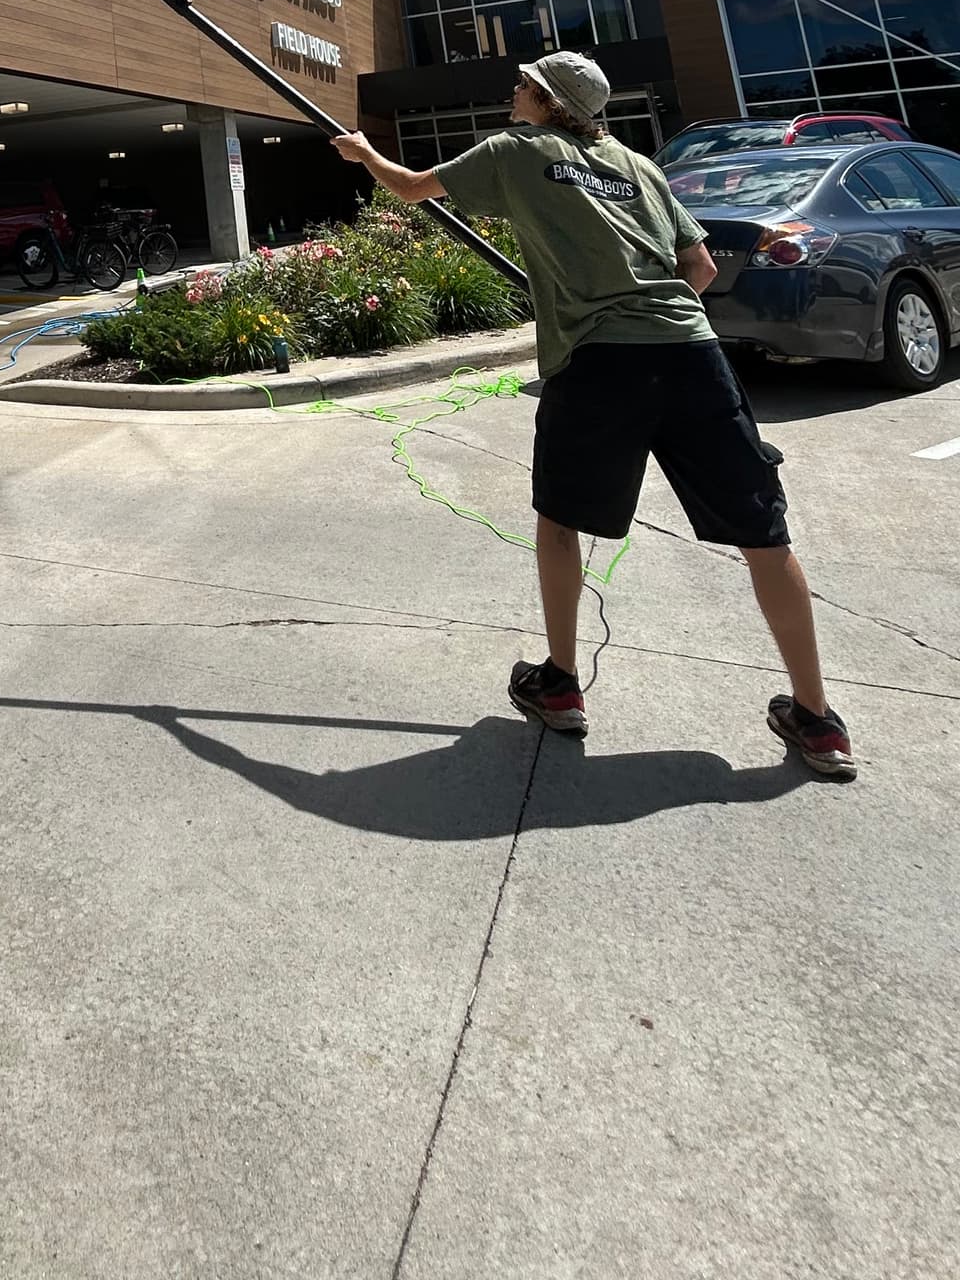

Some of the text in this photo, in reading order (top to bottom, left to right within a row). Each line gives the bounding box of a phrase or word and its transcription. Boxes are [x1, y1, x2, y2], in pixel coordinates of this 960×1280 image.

[271, 21, 342, 68] FIELD HOUSE
[603, 179, 634, 197] BOYS
